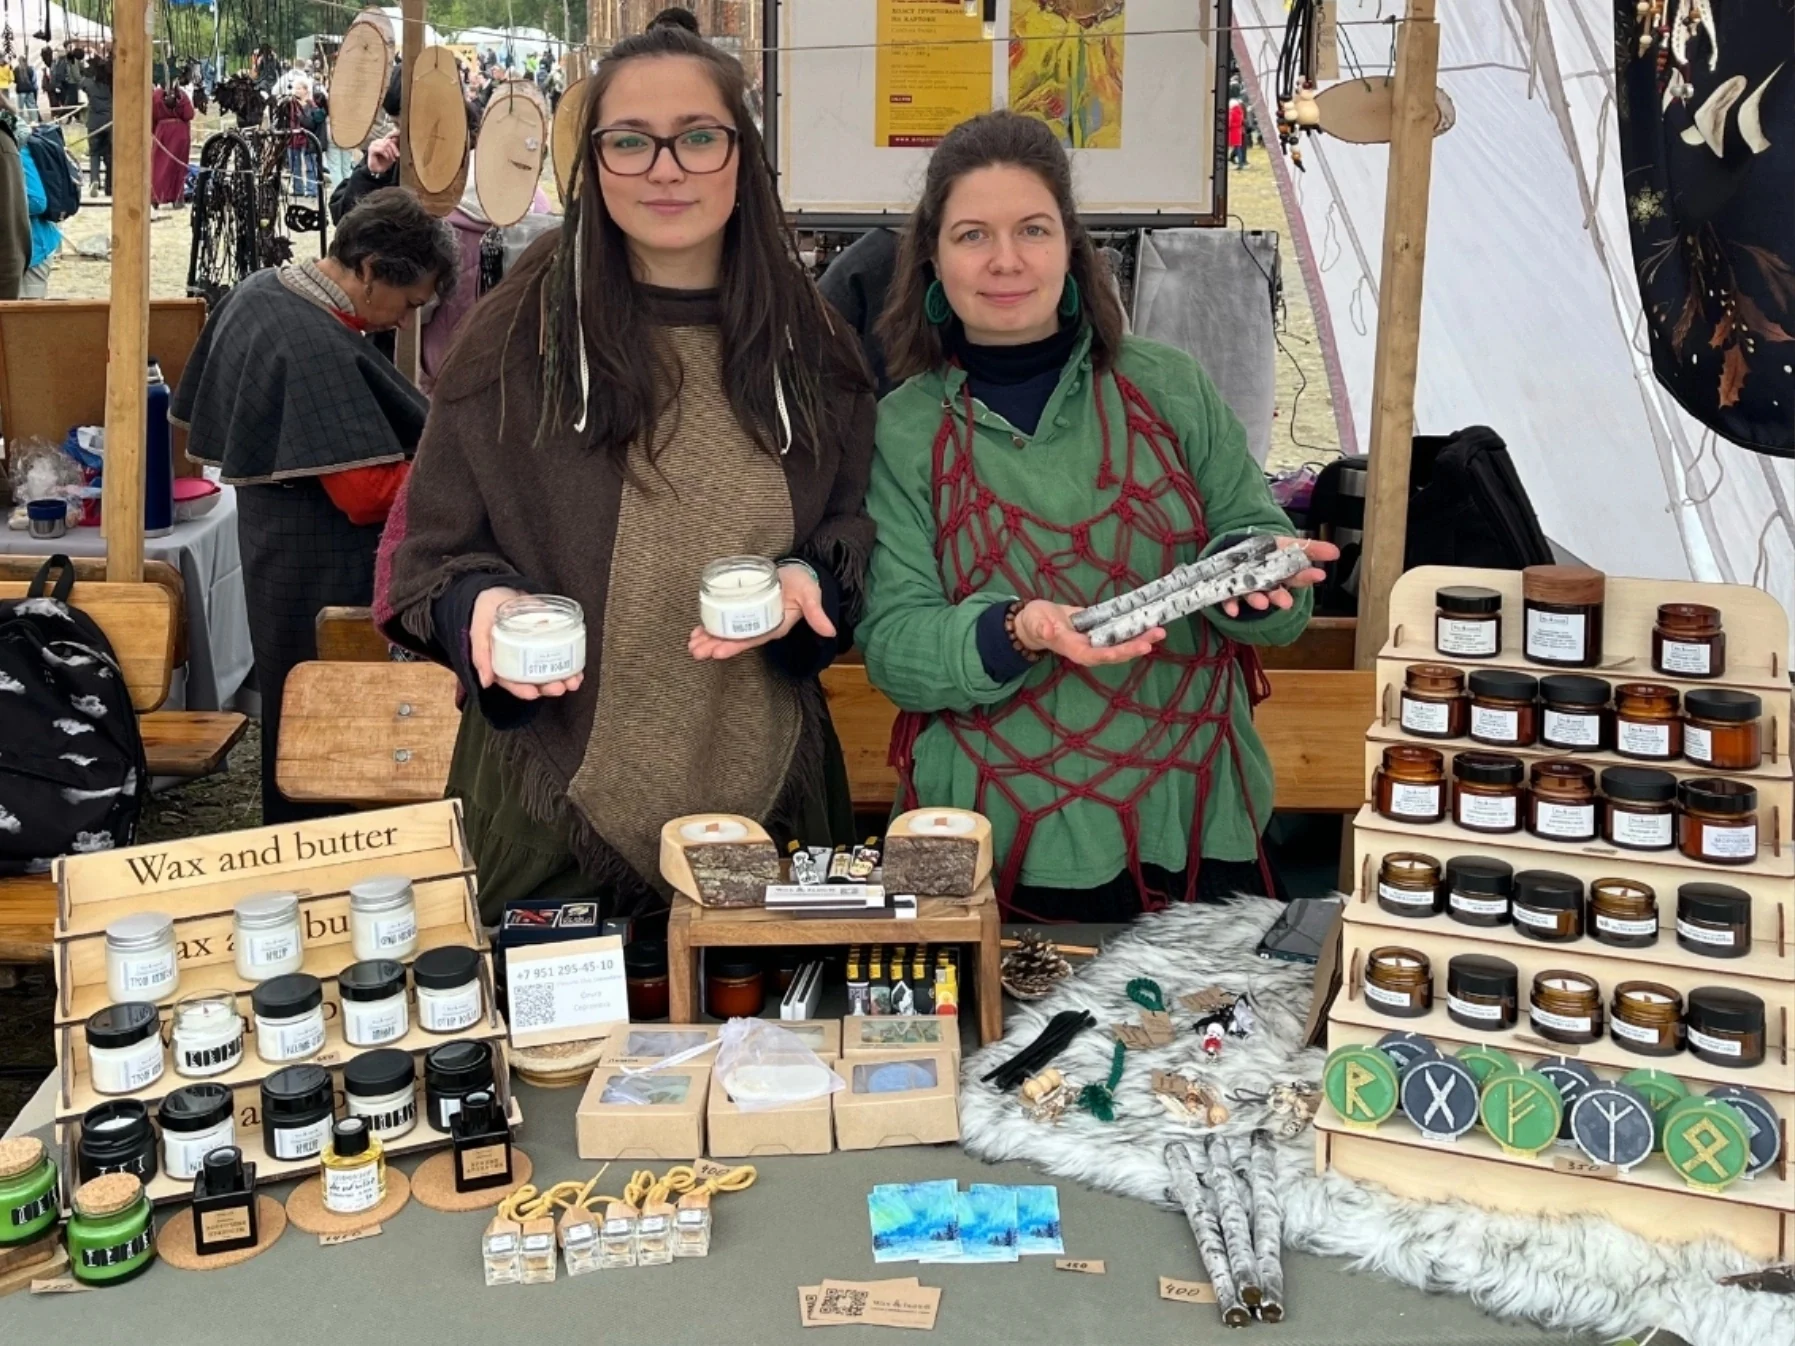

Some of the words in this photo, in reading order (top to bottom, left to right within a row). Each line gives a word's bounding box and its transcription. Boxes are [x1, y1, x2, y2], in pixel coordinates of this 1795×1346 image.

[126, 853, 206, 886] Wax
[219, 835, 281, 873] and
[296, 825, 398, 861] butter
[176, 937, 213, 961] ax
[517, 969, 530, 980] +7
[533, 967, 554, 979] 951
[557, 959, 614, 976] 295-45-10
[1567, 1160, 1601, 1172] 350
[1165, 1282, 1200, 1297] 400
